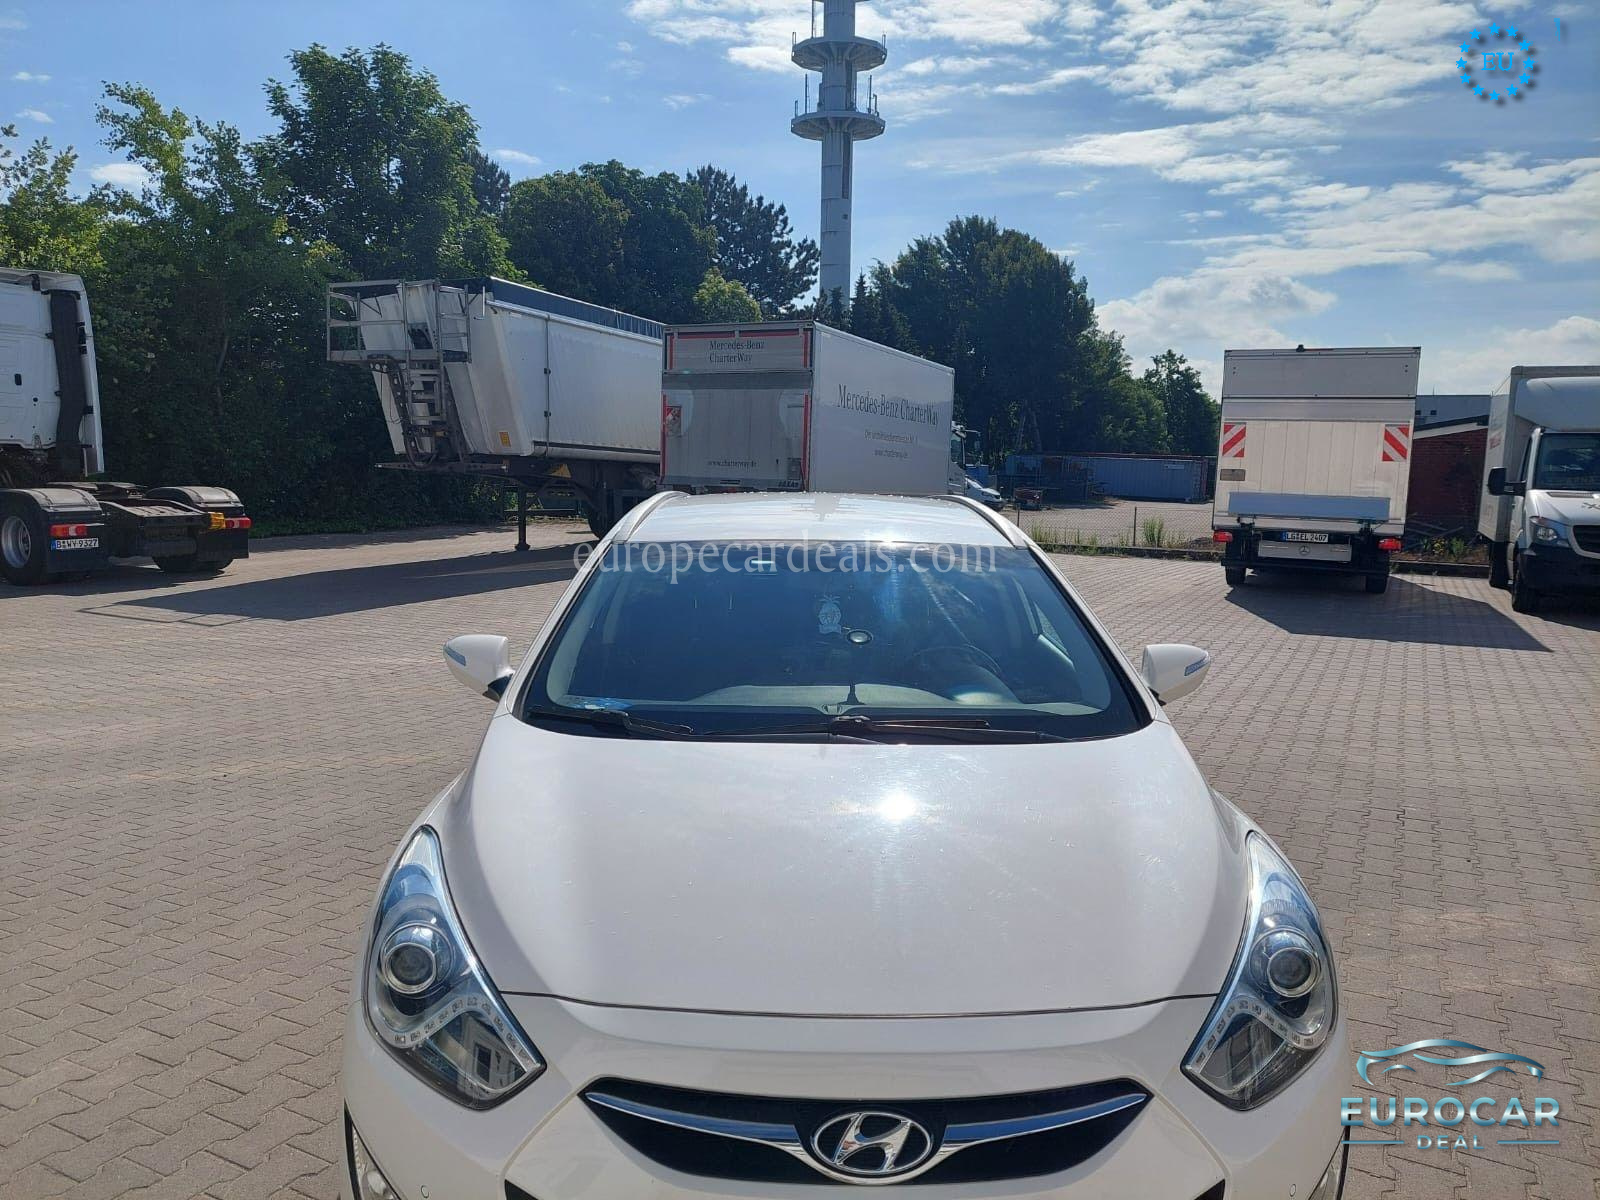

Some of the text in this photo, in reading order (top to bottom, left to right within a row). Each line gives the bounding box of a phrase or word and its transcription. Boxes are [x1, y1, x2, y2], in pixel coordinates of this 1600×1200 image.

[709, 340, 765, 350] Mercedes-Benz
[709, 352, 752, 364] CharterWay
[837, 383, 939, 427] Mercedes-Benz CharterWay
[1286, 532, 1296, 541] LG
[1310, 533, 1328, 542] 2407
